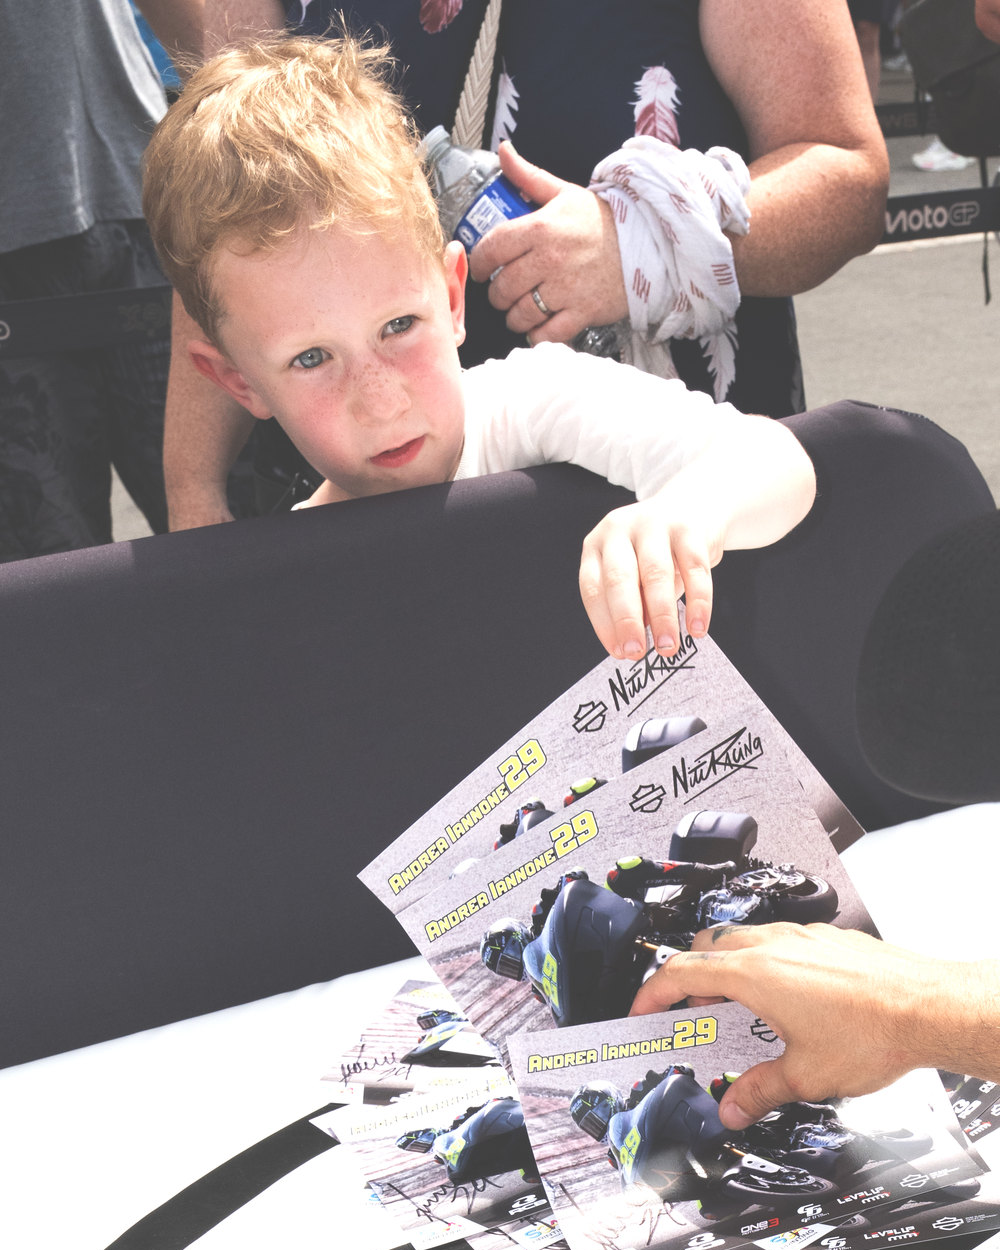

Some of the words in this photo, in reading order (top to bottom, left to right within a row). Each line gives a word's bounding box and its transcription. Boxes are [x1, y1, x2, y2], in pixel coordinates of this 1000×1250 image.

[387, 837, 450, 895] ANDREA
[444, 782, 510, 844] IANNONE
[496, 738, 547, 793] 29
[424, 891, 490, 942] ANDREA
[487, 848, 556, 900] IANNONE
[549, 809, 600, 859] 29
[527, 1049, 598, 1073] ANDREA
[601, 1036, 673, 1062] IANNONE
[672, 1015, 719, 1051] 29
